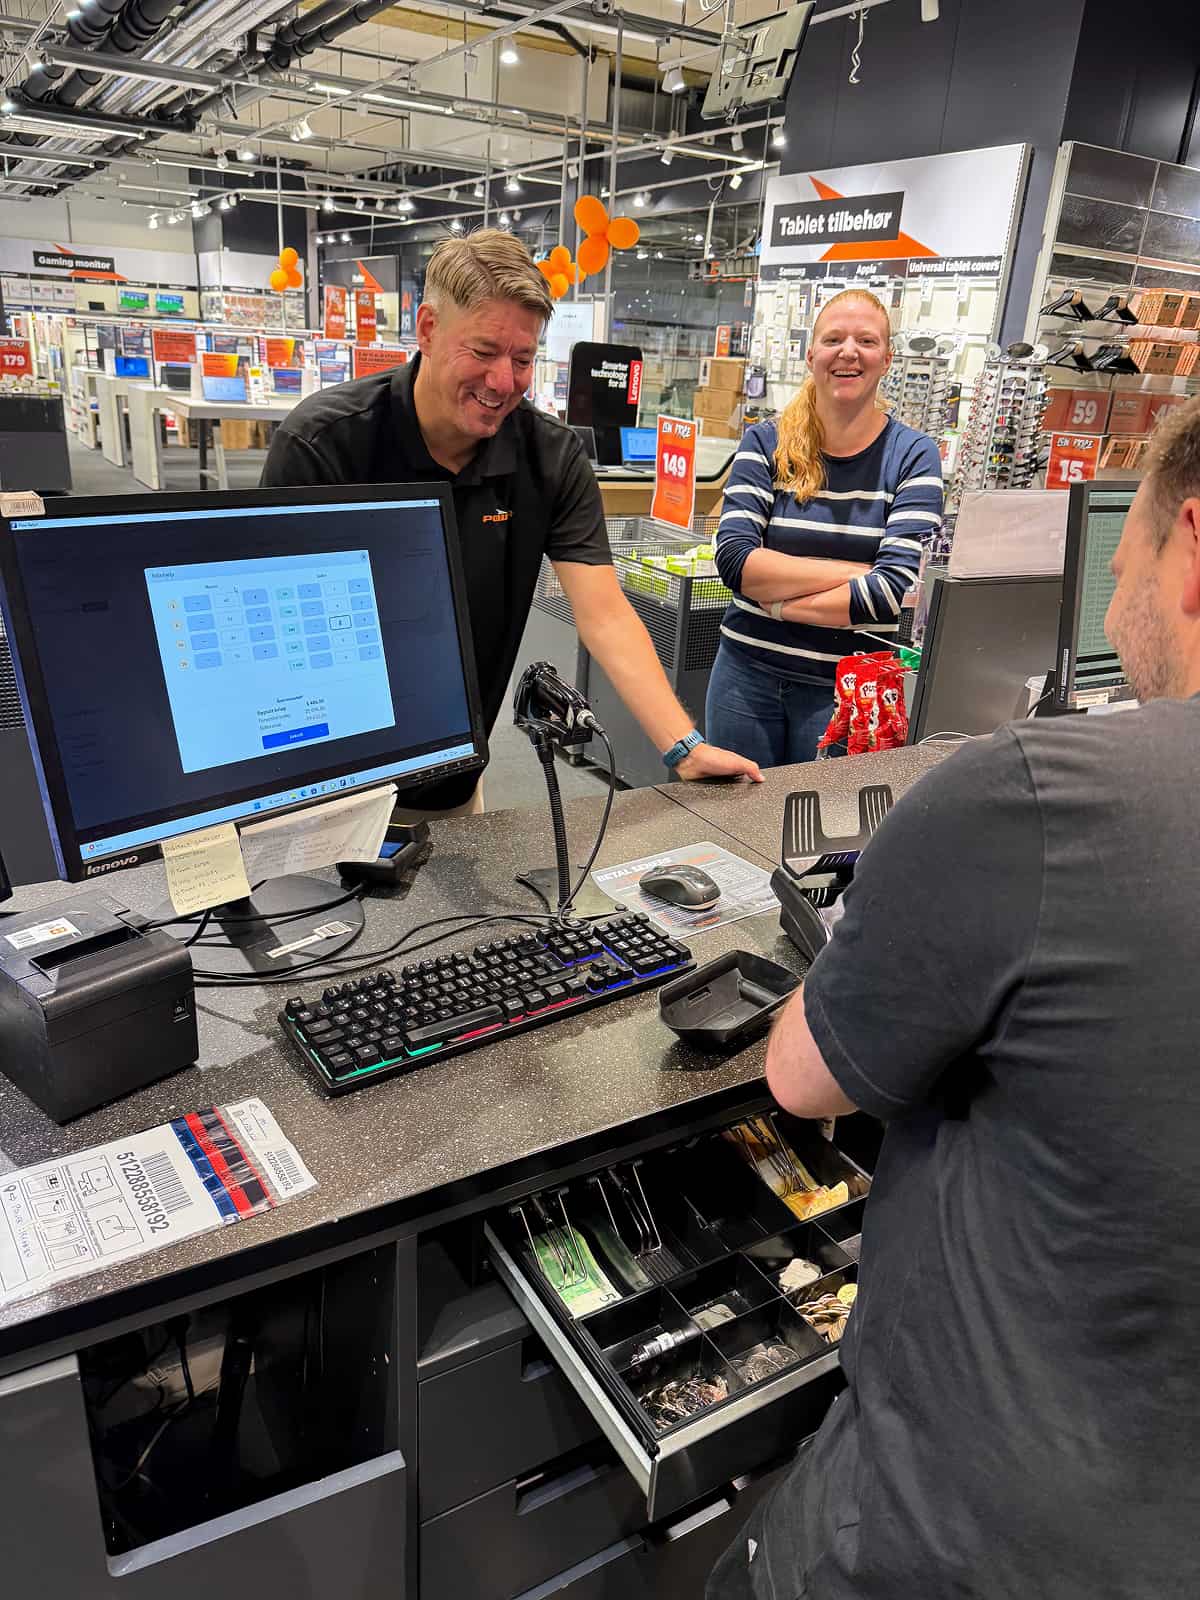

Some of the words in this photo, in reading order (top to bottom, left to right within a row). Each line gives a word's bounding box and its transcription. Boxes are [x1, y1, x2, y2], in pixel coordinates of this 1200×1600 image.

[779, 214, 825, 236] Tablet
[827, 208, 892, 233] tilbehør
[38, 256, 74, 268] Gaming
[75, 260, 111, 269] monitor
[856, 264, 877, 275] Apple
[909, 261, 945, 272] Universal
[945, 260, 971, 272] tablet
[971, 260, 1000, 271] covers
[3, 355, 25, 366] 179
[591, 368, 627, 380] technology
[630, 364, 641, 401] Lenovo
[1071, 399, 1097, 425] 59
[662, 452, 686, 478] 149
[1059, 459, 1084, 482] 15
[87, 855, 139, 875] lenovo
[116, 1151, 170, 1234] 512288558192
